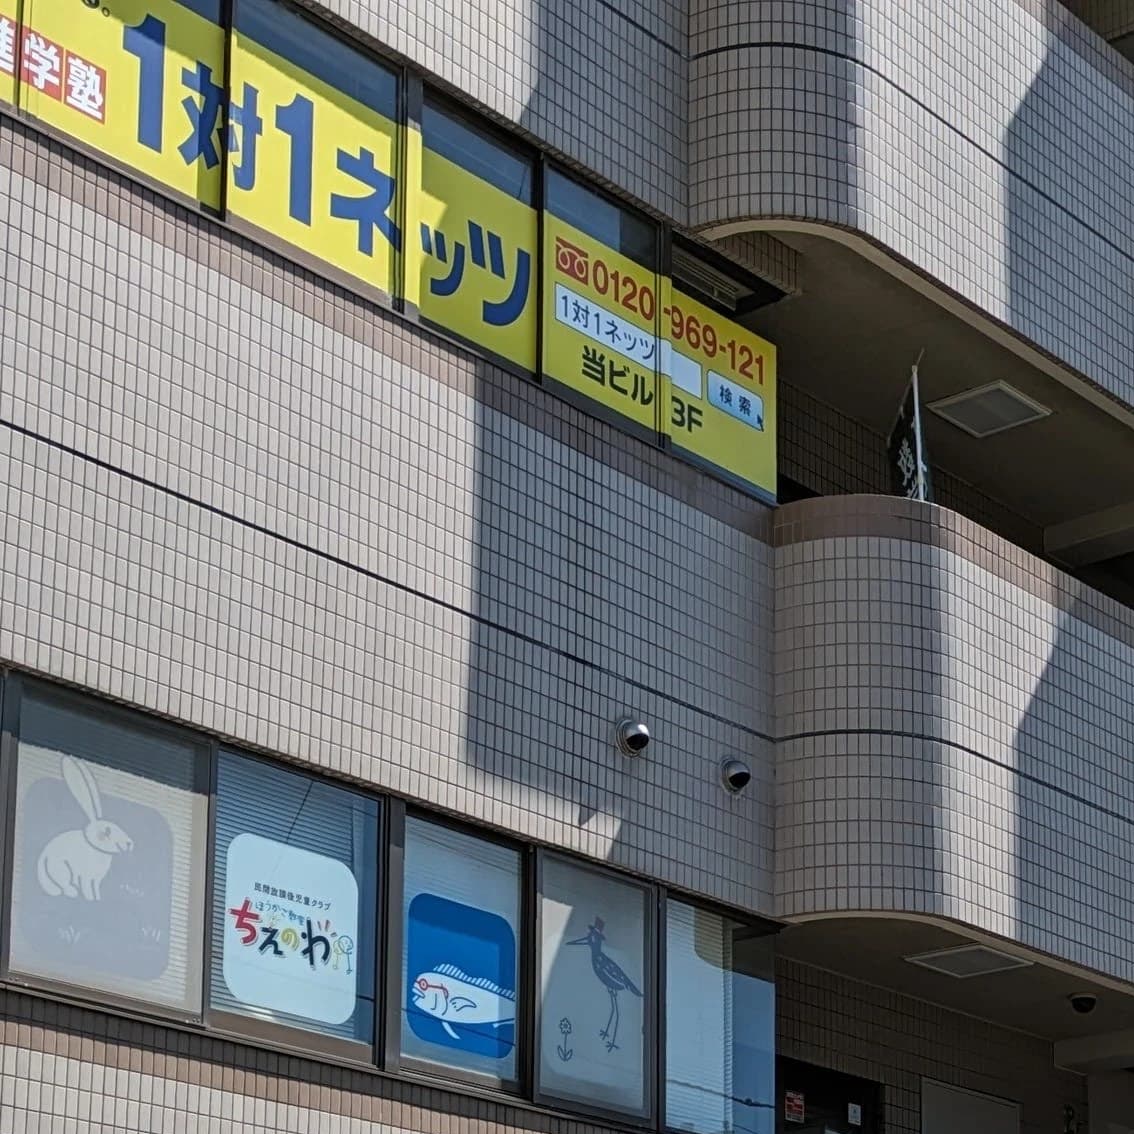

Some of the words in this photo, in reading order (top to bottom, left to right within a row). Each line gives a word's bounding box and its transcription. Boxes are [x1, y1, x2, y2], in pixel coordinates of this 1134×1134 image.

[562, 294, 656, 360] 1対1ネッツ
[592, 259, 764, 385] 0120-969-121
[581, 345, 654, 407] 当ビル
[671, 395, 704, 433] 3F
[228, 896, 333, 968] ちえのわ
